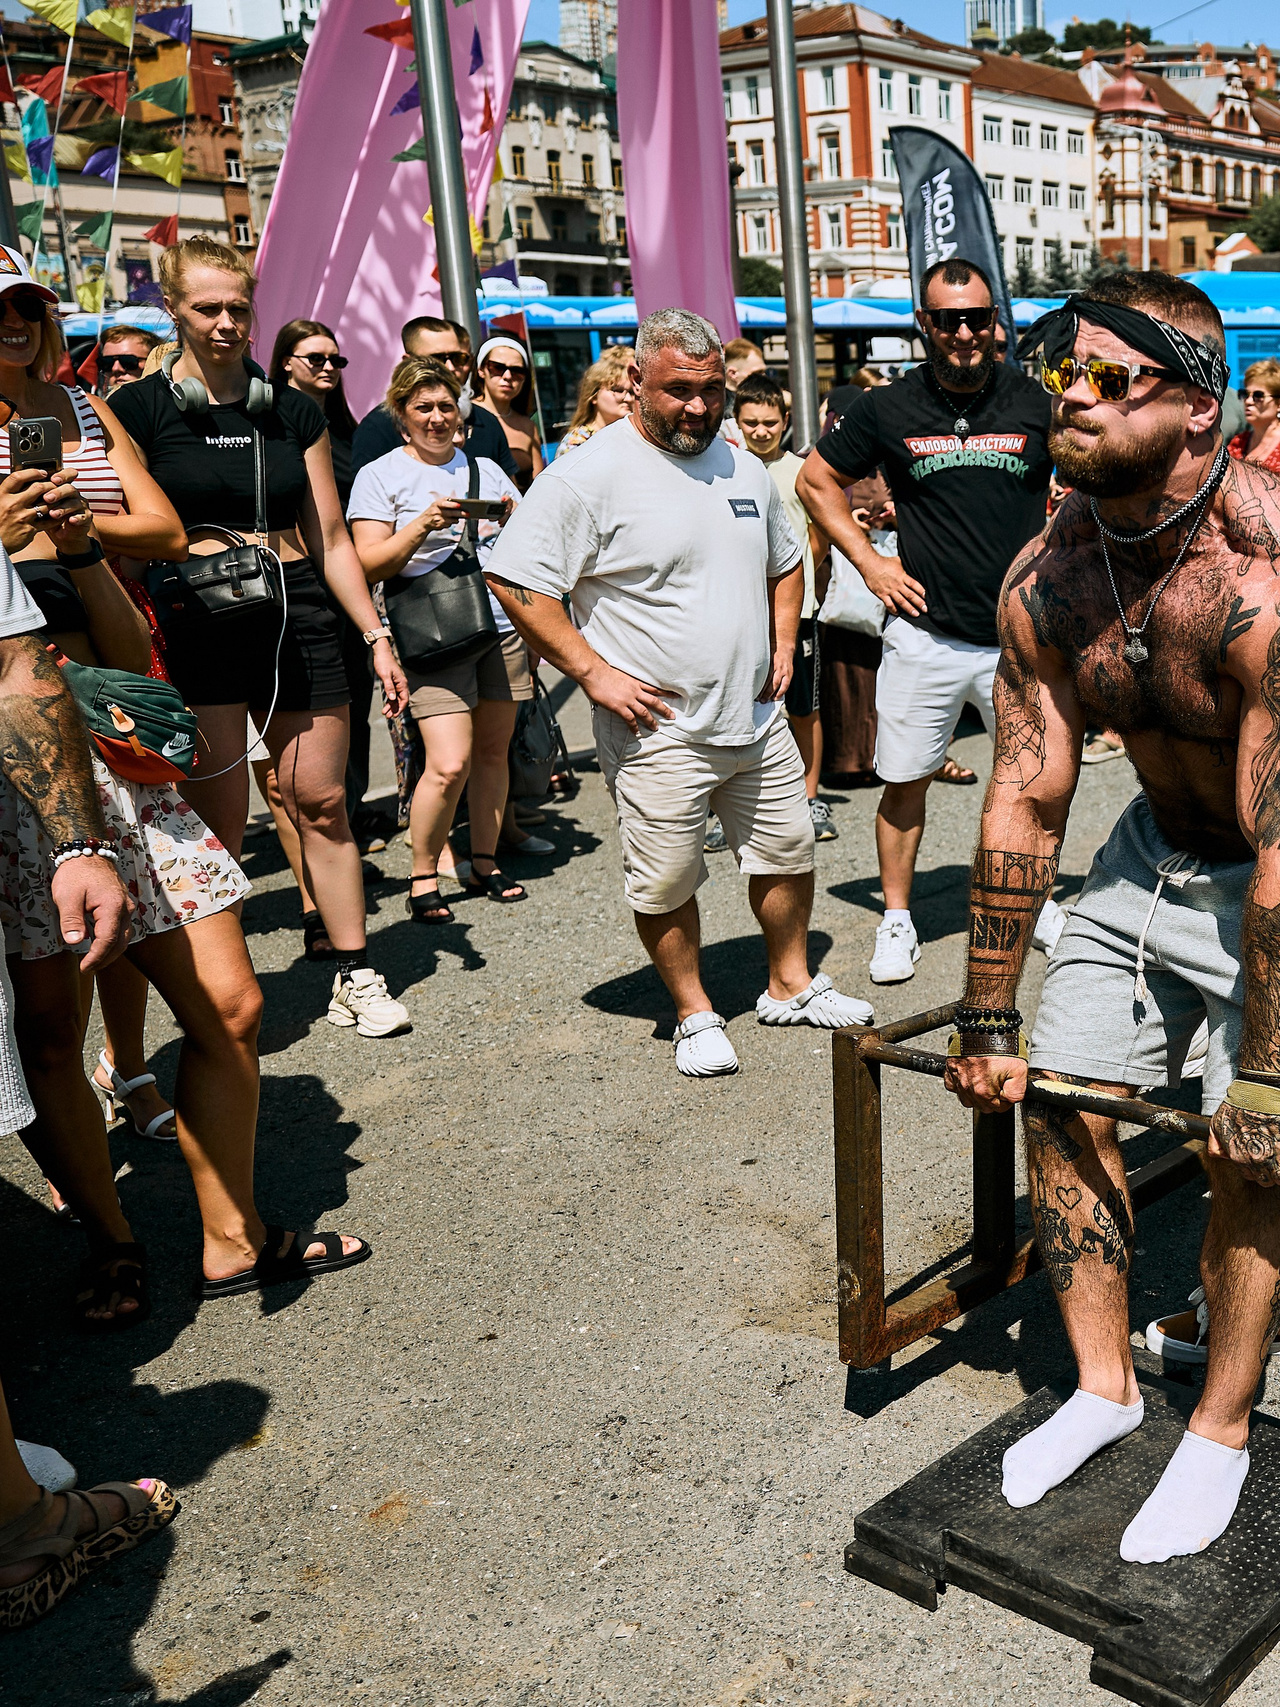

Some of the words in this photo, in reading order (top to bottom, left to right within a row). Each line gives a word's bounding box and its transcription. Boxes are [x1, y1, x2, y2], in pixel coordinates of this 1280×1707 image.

[205, 435, 252, 444] Inferno
[909, 437, 962, 453] СИЛОВОЙ
[965, 438, 1024, 450] ЭСКСТРИМ
